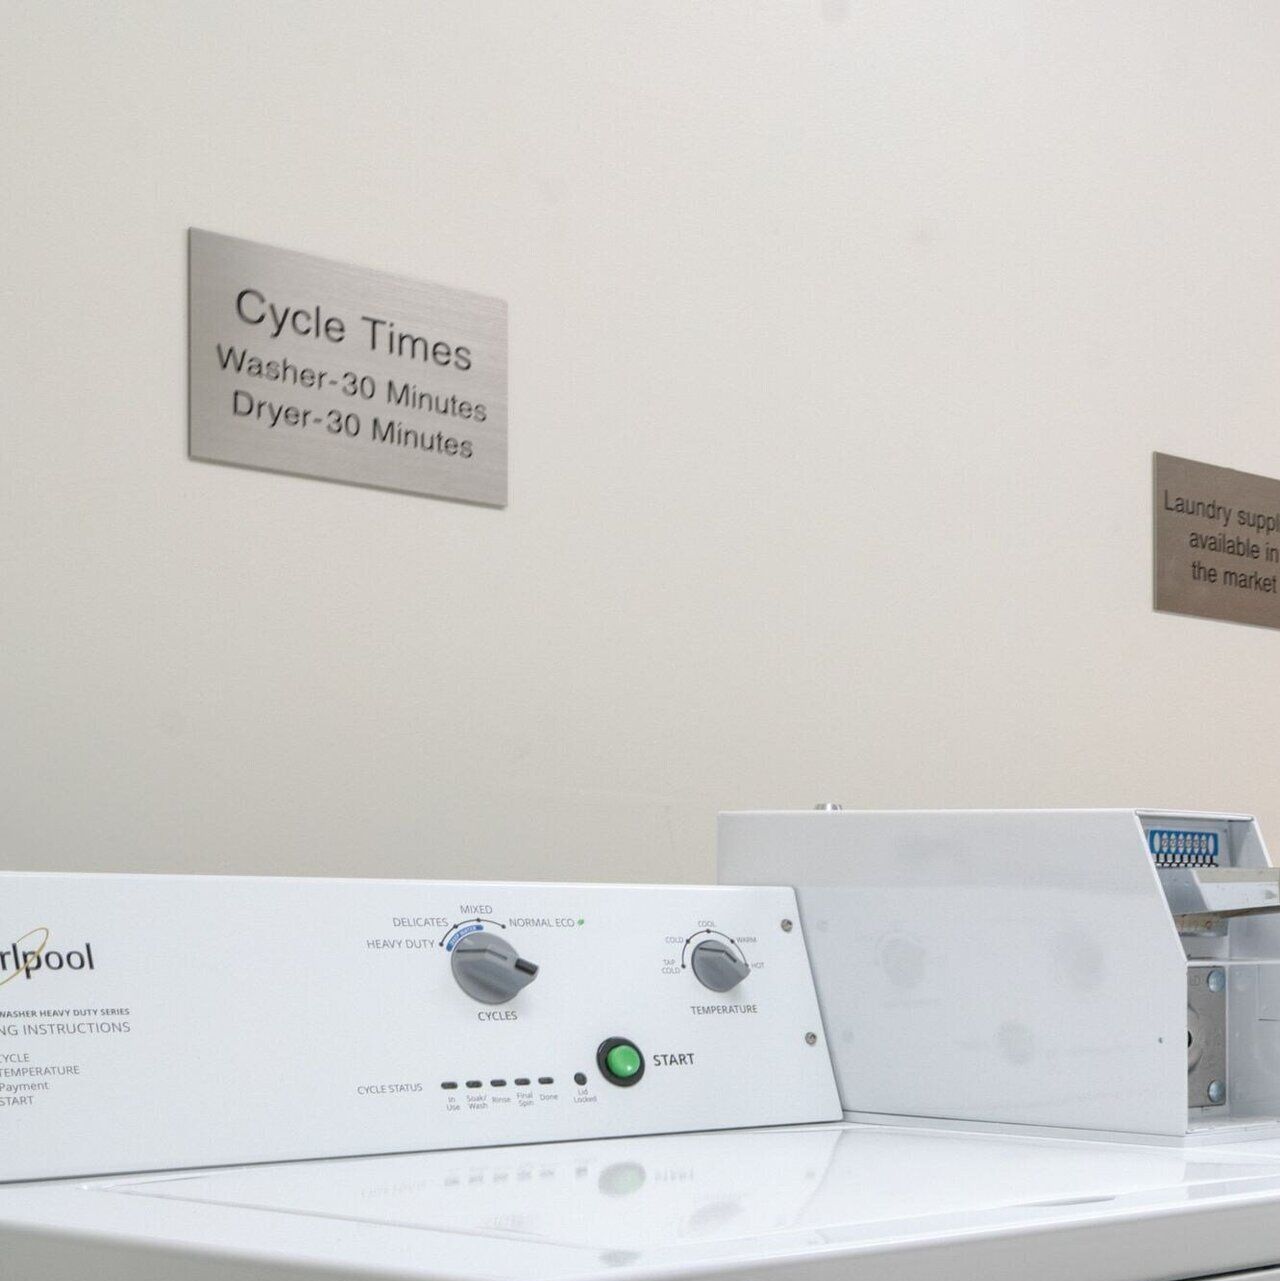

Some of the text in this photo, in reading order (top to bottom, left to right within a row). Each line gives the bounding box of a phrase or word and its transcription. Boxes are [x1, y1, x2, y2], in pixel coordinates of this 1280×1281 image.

[236, 288, 473, 372] Cycle Times
[216, 343, 488, 423] Washer-30 Minutes
[232, 390, 474, 459] Dryer-30 Minutes
[1164, 489, 1233, 527] Laundry
[1189, 532, 1280, 563] available in
[1191, 560, 1278, 594] the market
[460, 905, 493, 914] MIXED
[393, 917, 449, 927] DELICATES
[509, 918, 575, 928] NORMAL ECO
[698, 920, 716, 928] COOL
[367, 939, 435, 949] HEAVY DUTY
[665, 936, 684, 944] COLD
[39, 1009, 70, 1018] HEAVY
[73, 1009, 97, 1017] DUTY
[100, 1008, 130, 1016] SERIES
[478, 1011, 518, 1021] CYCLES
[691, 1005, 758, 1015] TEMPERATURE
[23, 1022, 131, 1036] INSTRUCTIONS
[653, 1053, 695, 1066] START
[0, 1082, 50, 1094] Payment
[357, 1083, 423, 1095] CYCLE STATUS
